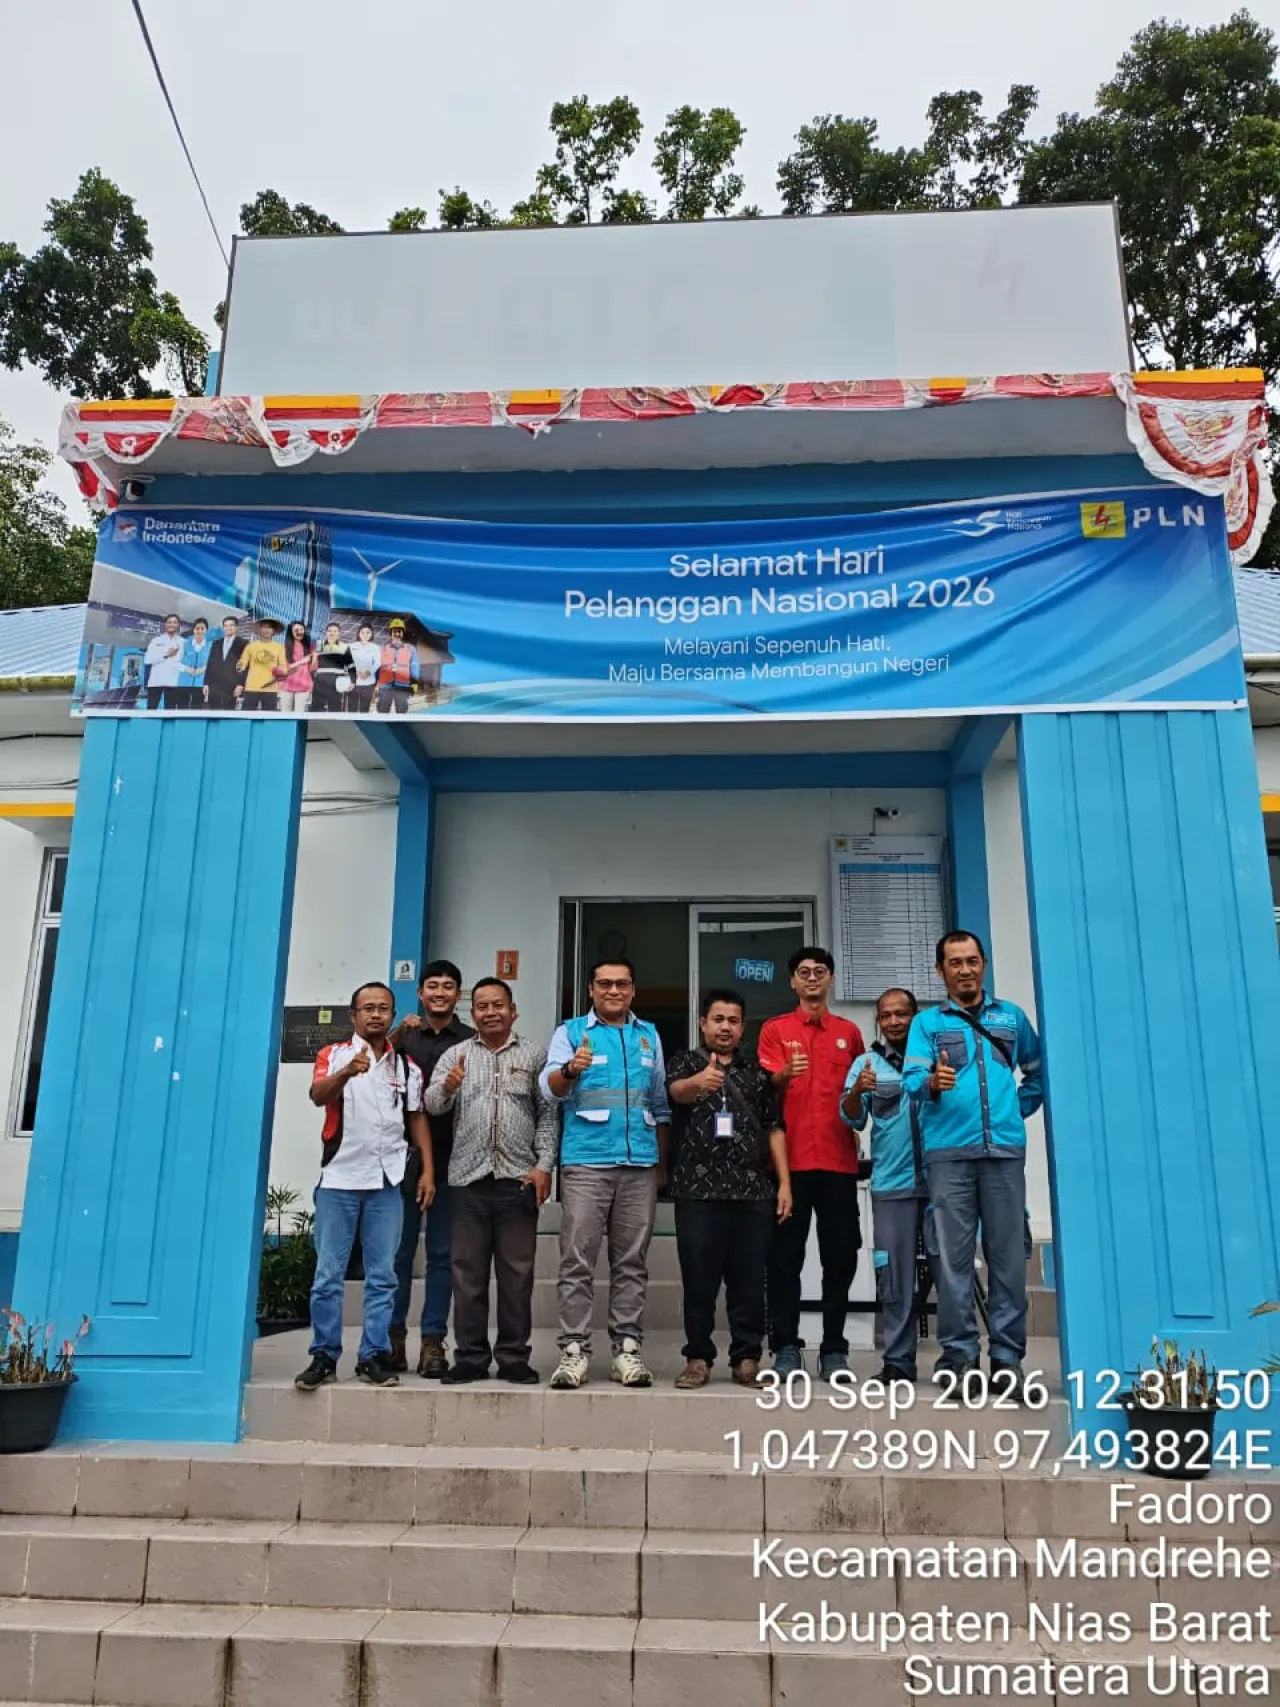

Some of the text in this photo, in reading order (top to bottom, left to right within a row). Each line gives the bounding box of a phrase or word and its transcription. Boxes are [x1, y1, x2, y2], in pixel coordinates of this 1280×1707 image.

[1133, 504, 1205, 529] PLN
[142, 531, 216, 545] Indonesia
[668, 545, 885, 577] Selamat Hari
[564, 577, 996, 624] Pelanggan Nasional 2026
[663, 633, 892, 659] Melayani Sepenuh Hati.
[608, 653, 950, 687] Maju Bersama Membangun Negeri
[738, 965, 770, 982] OPEN
